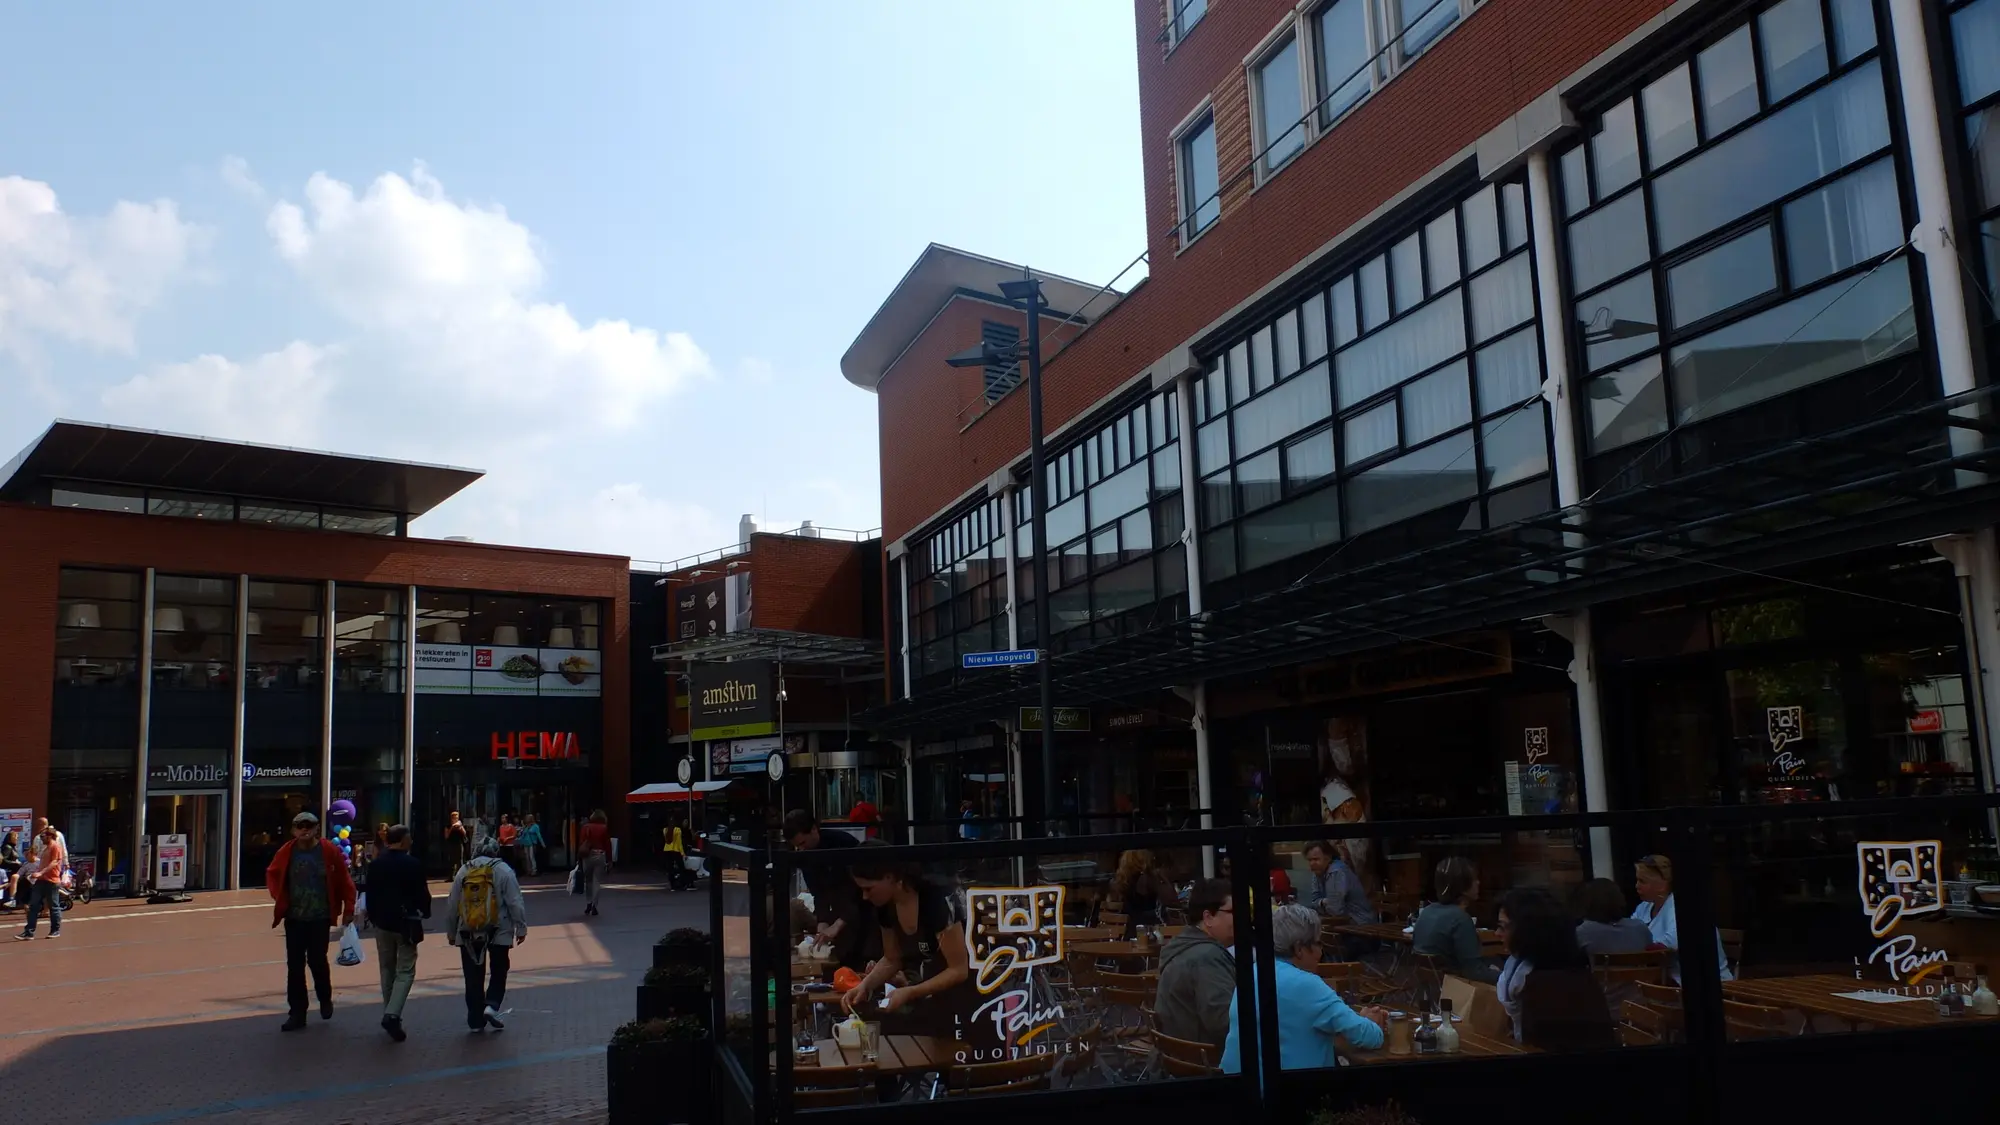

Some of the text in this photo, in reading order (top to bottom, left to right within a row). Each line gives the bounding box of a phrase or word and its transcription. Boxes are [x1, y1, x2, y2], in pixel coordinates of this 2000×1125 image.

[968, 652, 1031, 664] Nieuw Loopveld
[703, 680, 757, 706] amstlvn
[1126, 713, 1143, 724] LEVELT
[490, 731, 580, 760] HEMA
[166, 764, 224, 782] Mobile
[255, 766, 312, 777] Amstelveen
[1528, 764, 1550, 781] Pain
[1772, 752, 1806, 774] Pain
[1868, 934, 1948, 981] Pain
[971, 989, 1065, 1041] Pain
[955, 1041, 1090, 1064] QUOTIDIEN
